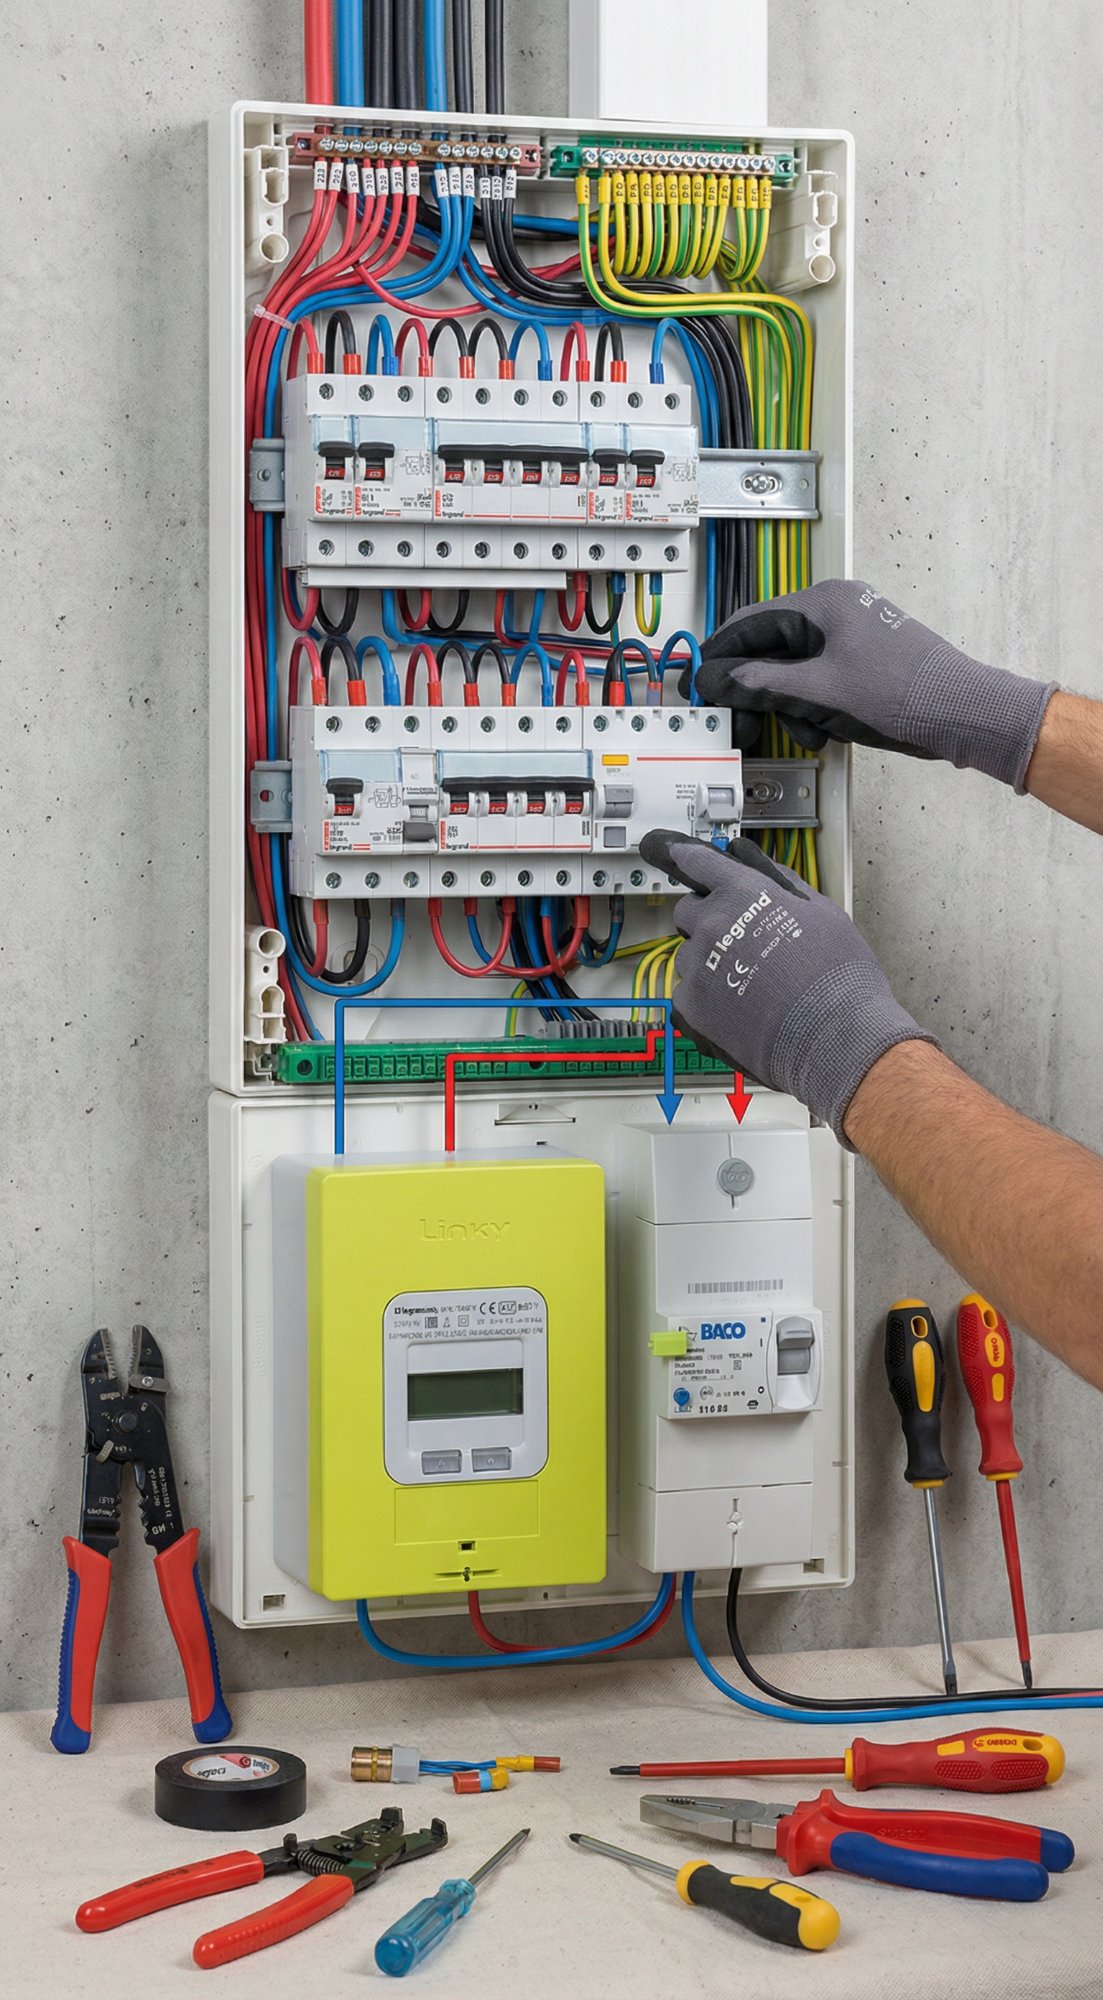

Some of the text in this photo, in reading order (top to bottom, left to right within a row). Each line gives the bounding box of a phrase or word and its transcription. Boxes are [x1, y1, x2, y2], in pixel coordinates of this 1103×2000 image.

[715, 890, 772, 952] legrand
[727, 959, 749, 988] CE
[479, 1301, 497, 1315] CE
[701, 1322, 747, 1341] BACO
